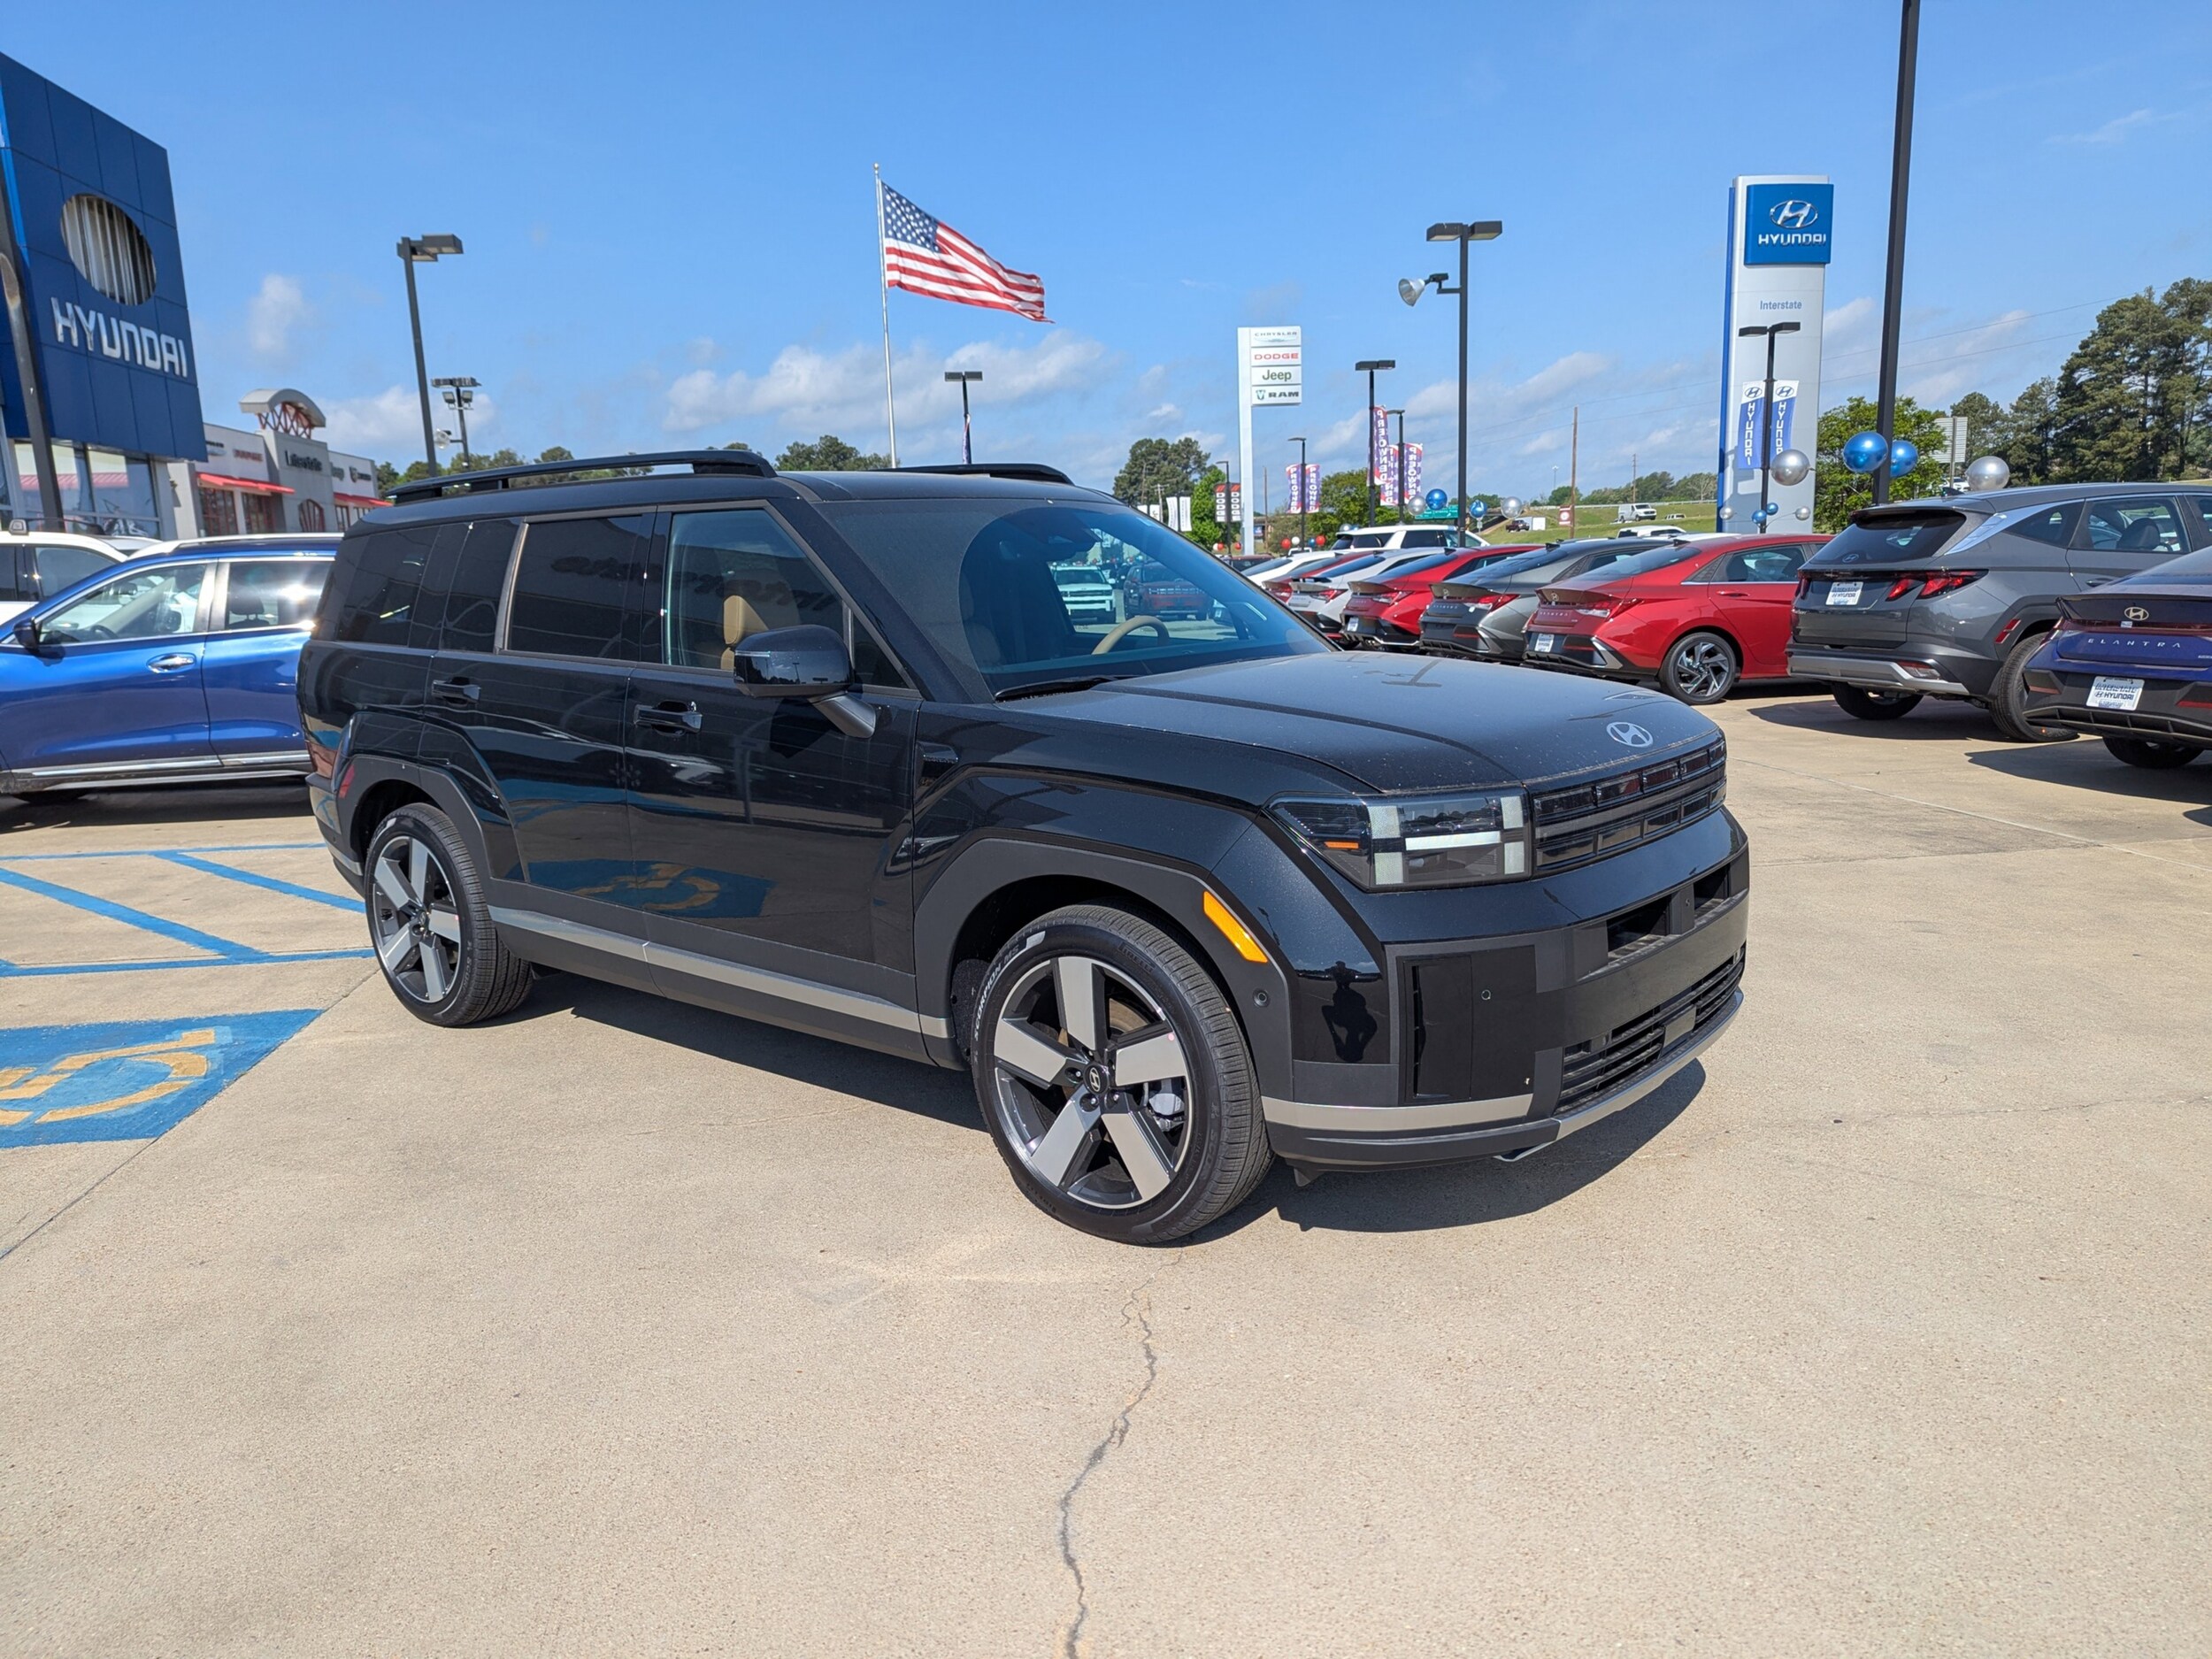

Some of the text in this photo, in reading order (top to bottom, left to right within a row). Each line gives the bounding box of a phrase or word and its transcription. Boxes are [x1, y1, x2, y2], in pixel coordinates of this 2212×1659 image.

[1757, 233, 1827, 246] HYUNDAI
[1760, 300, 1802, 311] Interstate
[50, 296, 188, 378] HYUNDAI
[1262, 369, 1292, 382] Jeep
[1744, 402, 1756, 466] HYUNDAI
[1775, 401, 1787, 456] HYUNDA
[2087, 638, 2181, 649] ELANTRA
[974, 963, 1002, 1041] SCORPION
